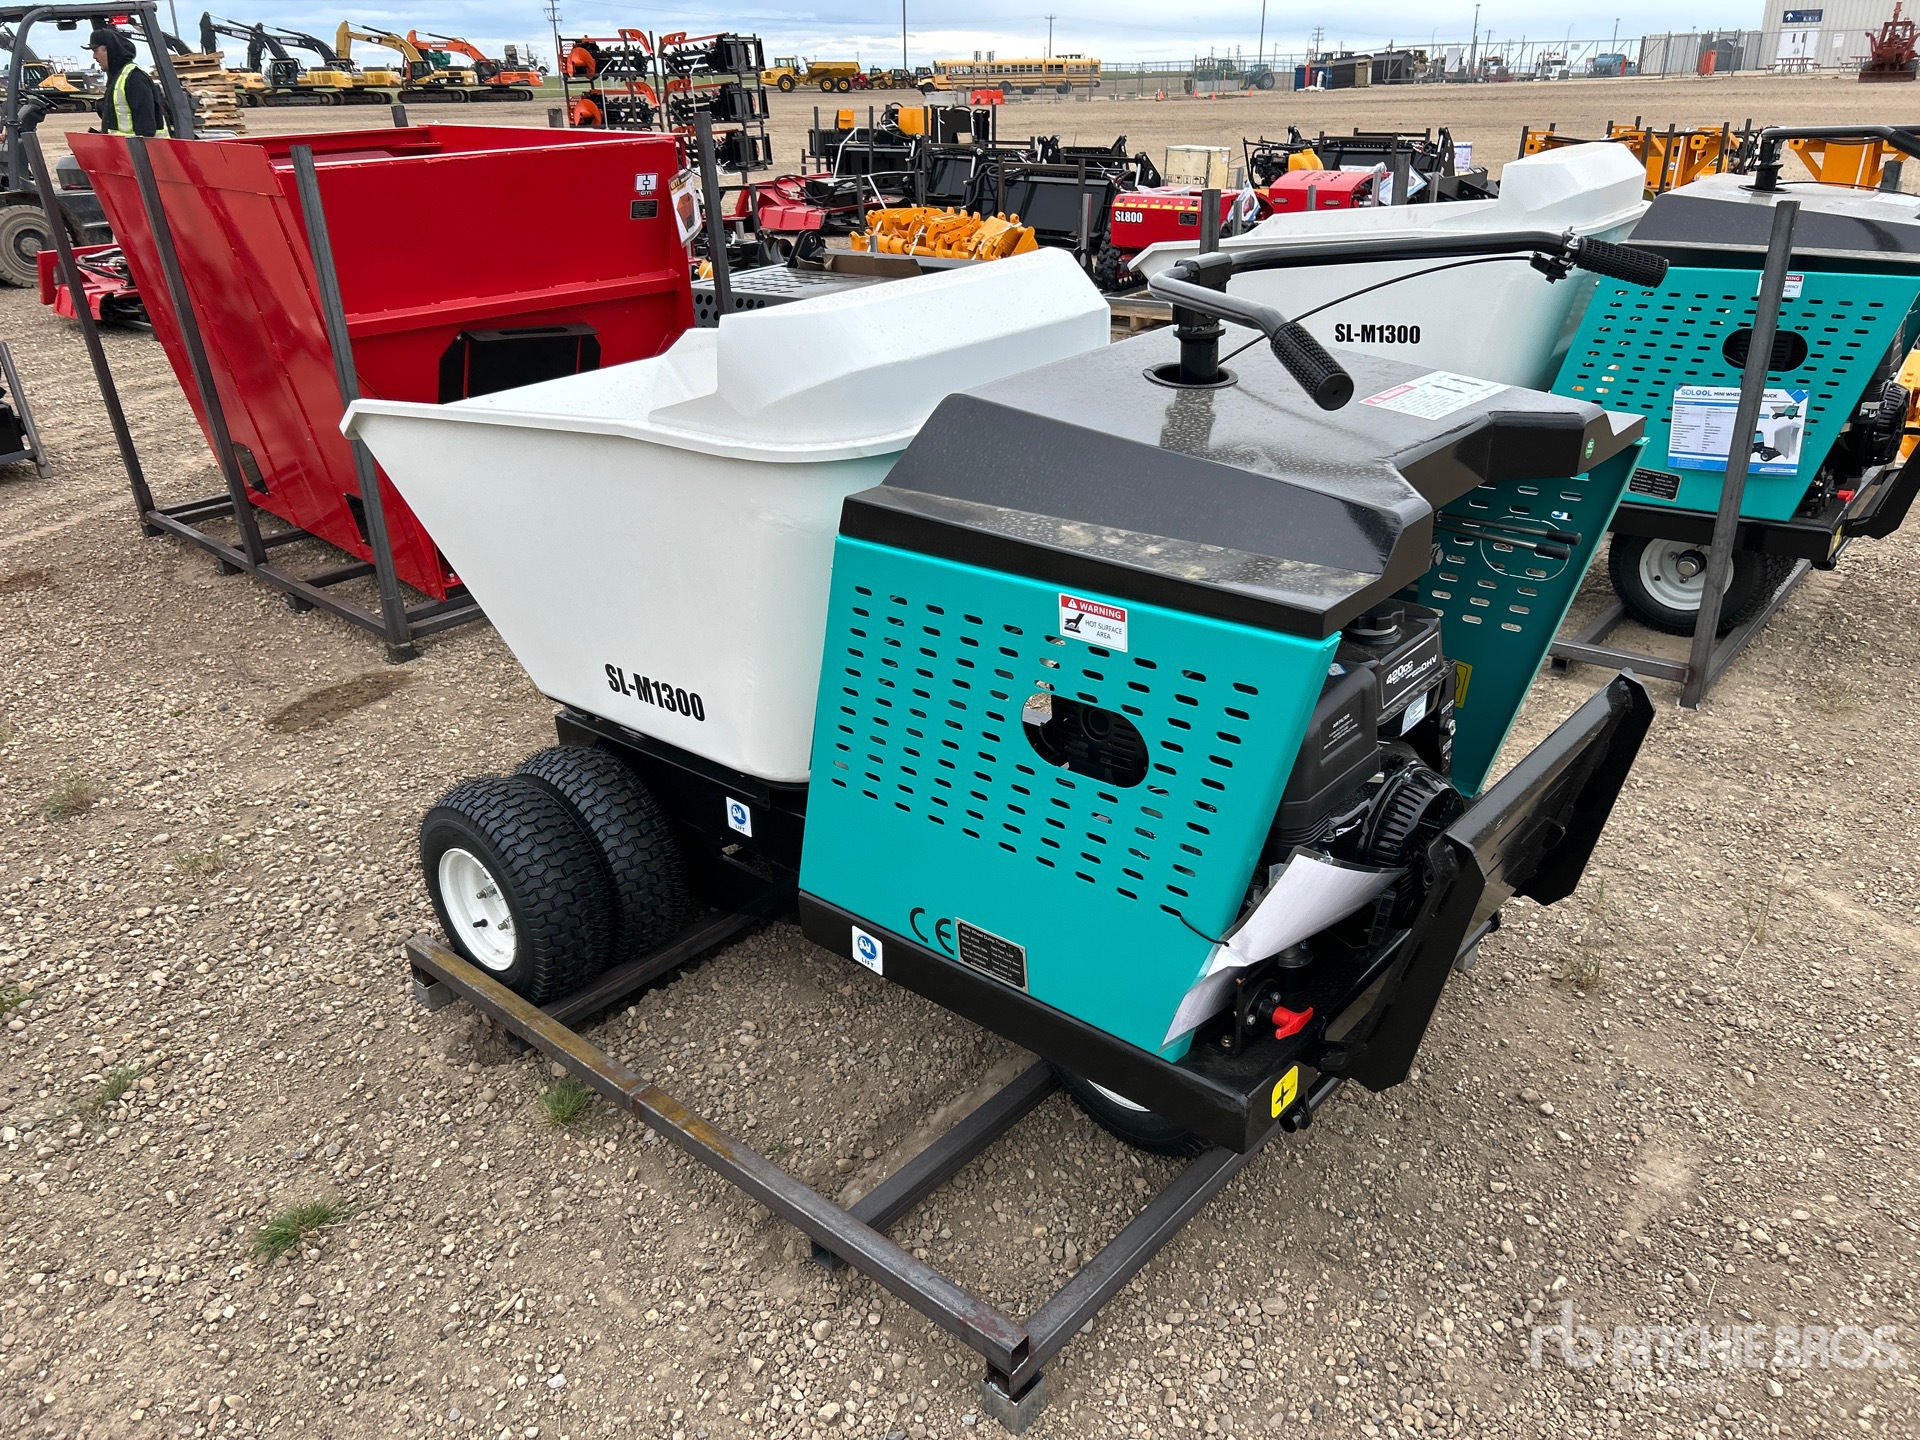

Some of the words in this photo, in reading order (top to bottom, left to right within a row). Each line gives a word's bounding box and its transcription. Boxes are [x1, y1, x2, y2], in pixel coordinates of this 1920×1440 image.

[1114, 210, 1143, 223] SL800
[1334, 323, 1421, 344] SL-M1300
[1080, 602, 1121, 619] WARNING
[1085, 620, 1097, 628] HOT
[1098, 622, 1122, 635] SURFACE
[1096, 630, 1111, 640] AREA
[1386, 660, 1414, 685] 420cc
[1421, 654, 1437, 671] OHV
[604, 663, 705, 722] SL-M1300
[735, 823, 745, 833] LIFT
[861, 956, 875, 969] LIFT
